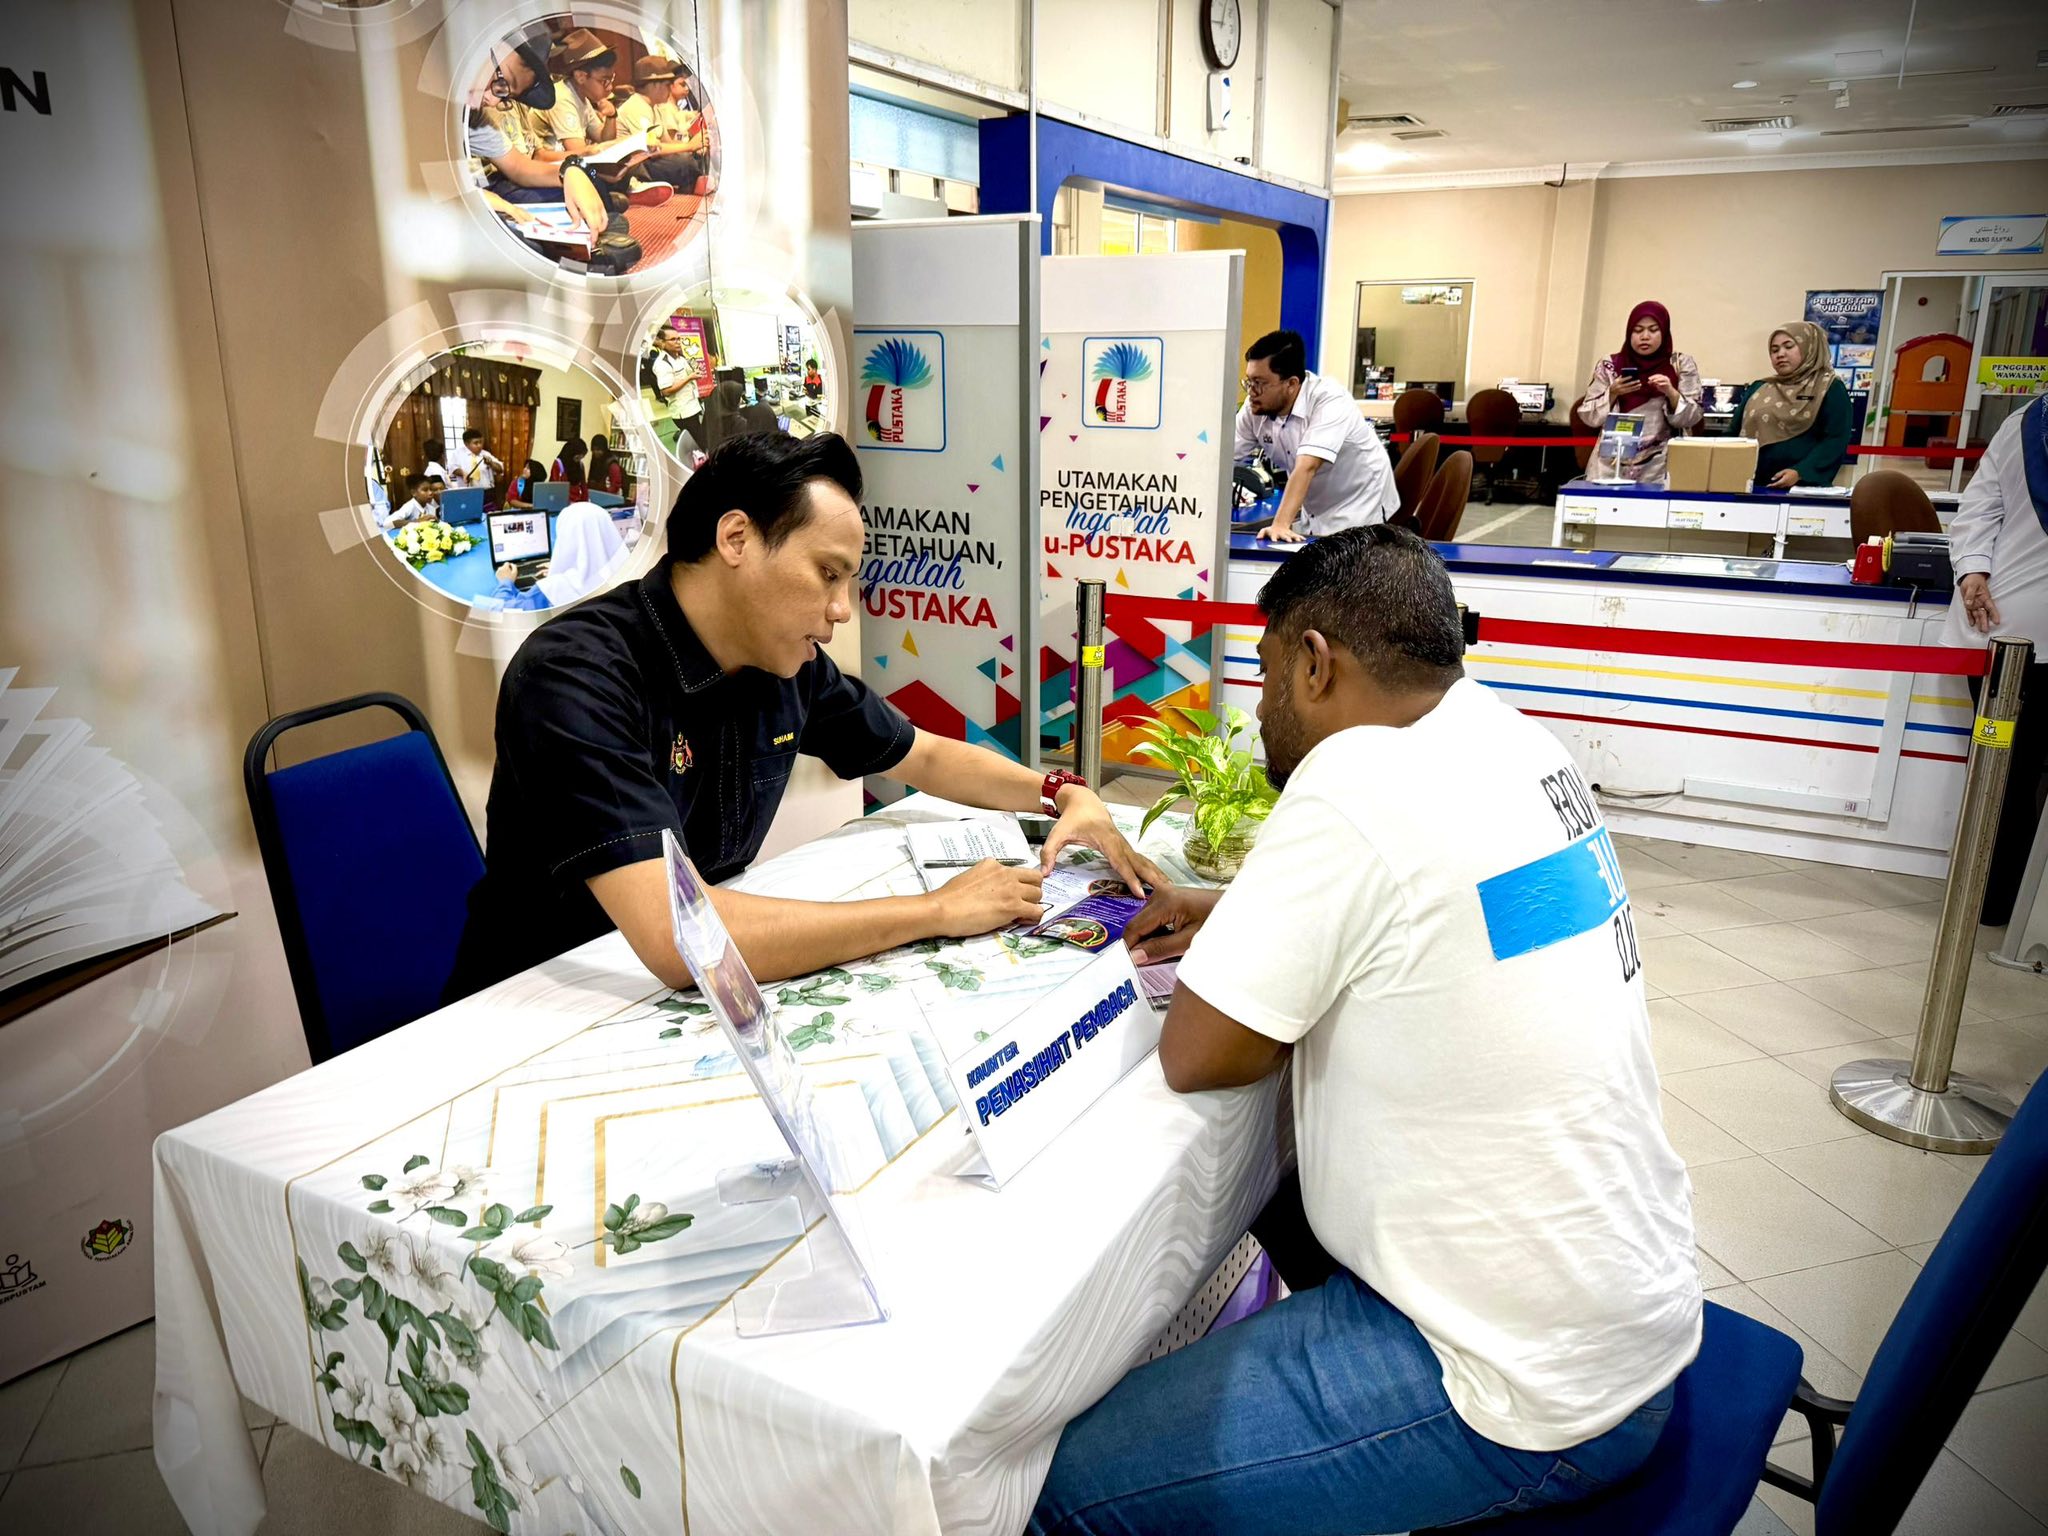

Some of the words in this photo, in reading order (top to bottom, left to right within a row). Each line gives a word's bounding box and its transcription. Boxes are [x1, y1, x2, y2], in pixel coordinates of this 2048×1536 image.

[1812, 296, 1876, 305] PERPUSTAM
[1820, 304, 1865, 313] VIRTUAL
[891, 387, 904, 443] PUSTAKA
[1116, 380, 1127, 423] PUSTAKA
[1057, 470, 1178, 493] UTAMAKAN
[1040, 490, 1203, 519] PENGETAHUAN,
[1044, 533, 1196, 565] u-PUSTAKA
[859, 551, 965, 601] gatlah
[859, 587, 998, 630] USTAKA
[966, 1040, 1021, 1089] KAUNTER
[975, 1030, 1073, 1127] PENASIHAT
[1070, 978, 1139, 1050] PEMBACA
